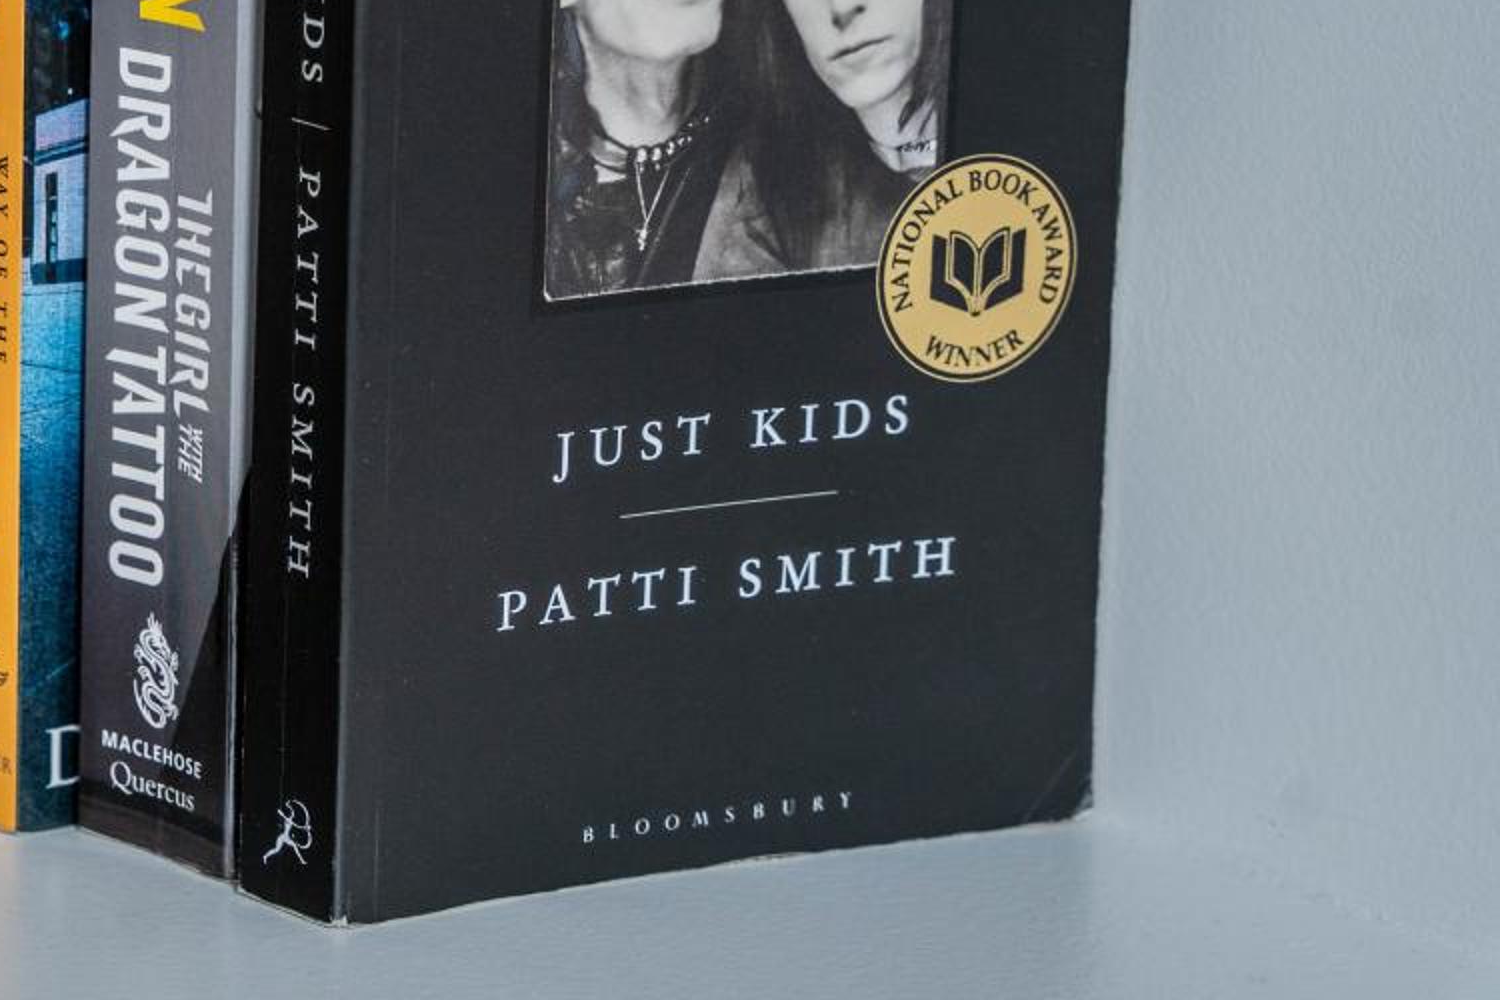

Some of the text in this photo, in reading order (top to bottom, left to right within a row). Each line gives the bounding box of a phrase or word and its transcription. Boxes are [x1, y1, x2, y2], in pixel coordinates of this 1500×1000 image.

[294, 167, 322, 351] PATTI
[890, 169, 1064, 313] NATIONAL BOOK AWARD
[105, 46, 172, 588] DRAGON TATTOO
[167, 188, 213, 419] THE GIRL
[925, 328, 1025, 368] WINNER
[177, 423, 193, 477] THE
[287, 383, 316, 579] SMITH
[552, 394, 911, 484] JUST KIDS
[496, 536, 956, 632] PATTI SMITH
[101, 729, 203, 780] MACLEHOSE
[109, 760, 196, 812] Quercus
[581, 791, 854, 844] BLOOMSBURY
